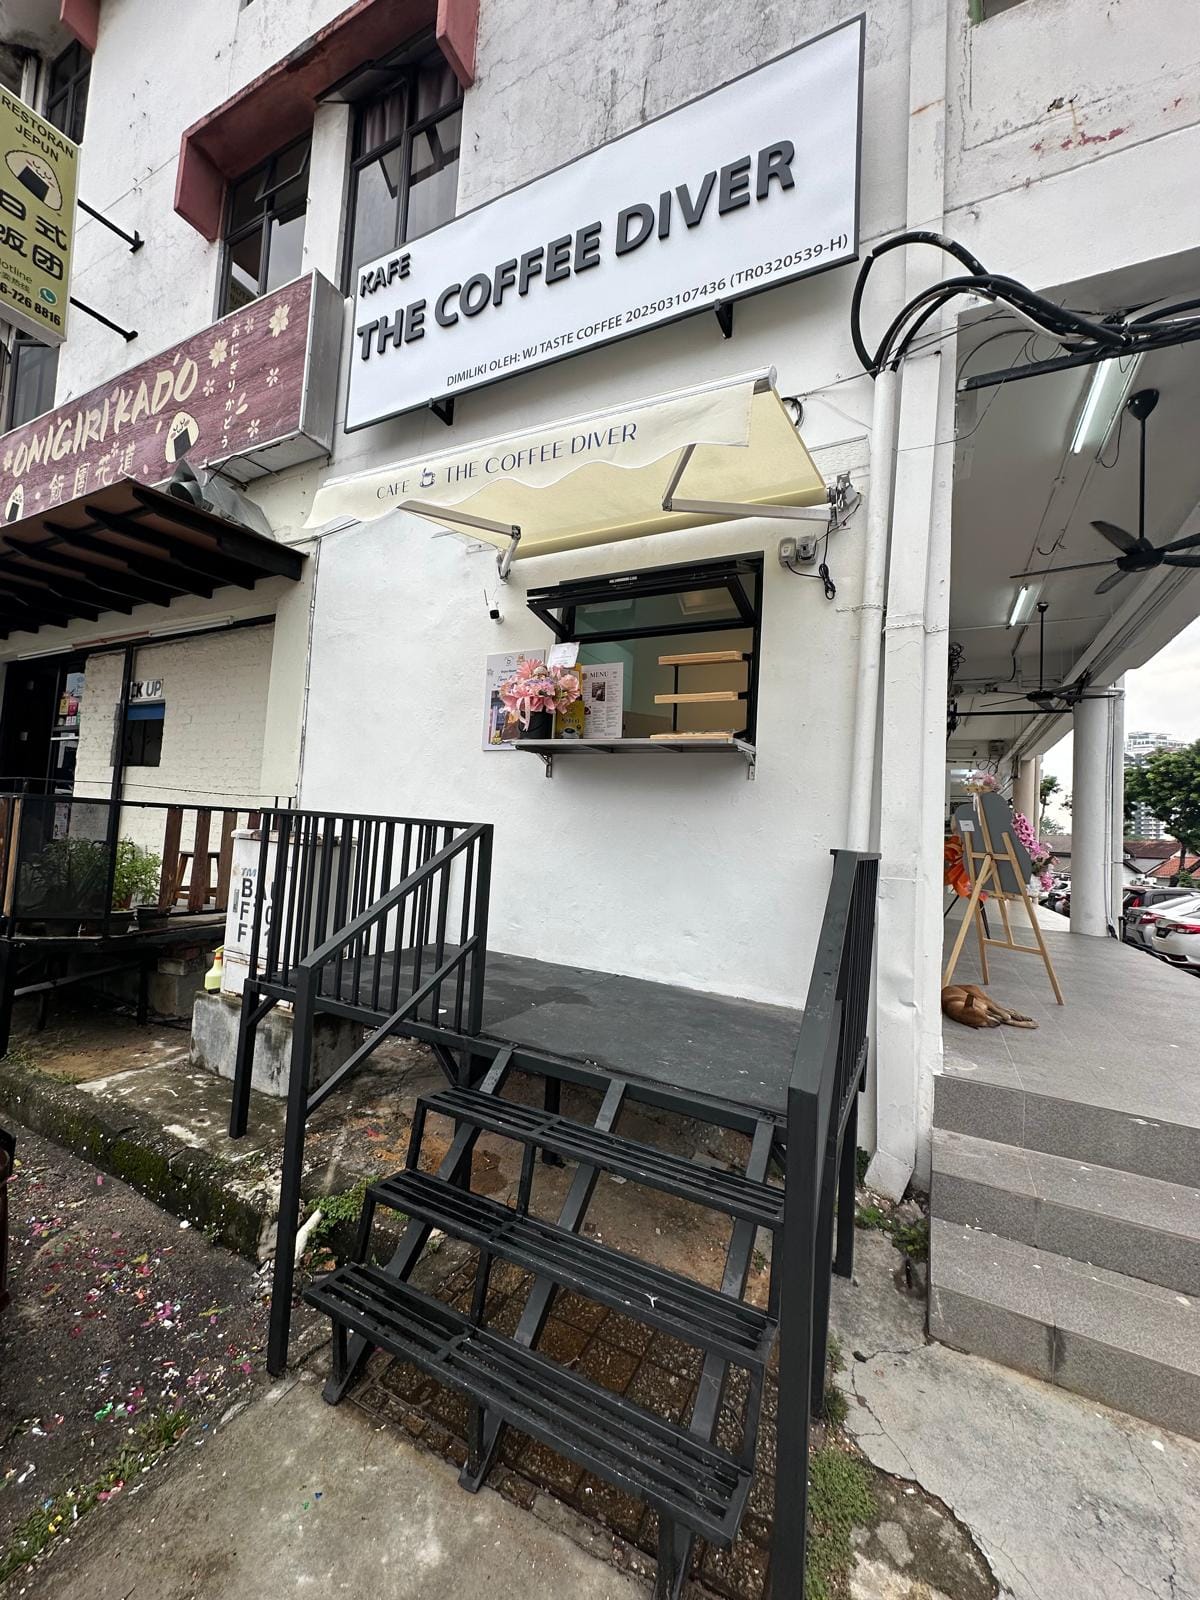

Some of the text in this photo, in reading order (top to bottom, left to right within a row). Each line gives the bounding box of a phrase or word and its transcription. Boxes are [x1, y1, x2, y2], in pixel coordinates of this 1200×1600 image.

[1, 95, 74, 159] RESTORAN
[15, 124, 59, 162] JEPUN
[356, 140, 796, 361] THE COFFEE DIVER
[360, 252, 411, 298] KAFE
[34, 302, 61, 327] 8816
[446, 233, 849, 387] DIMILIKI OLEH: WJ TASTE COFFEE 202503107436 (TR0320539-H)
[376, 422, 638, 500] CAFE THE COFFEE DIVER
[146, 680, 162, 697] UP
[590, 670, 609, 679] MENU
